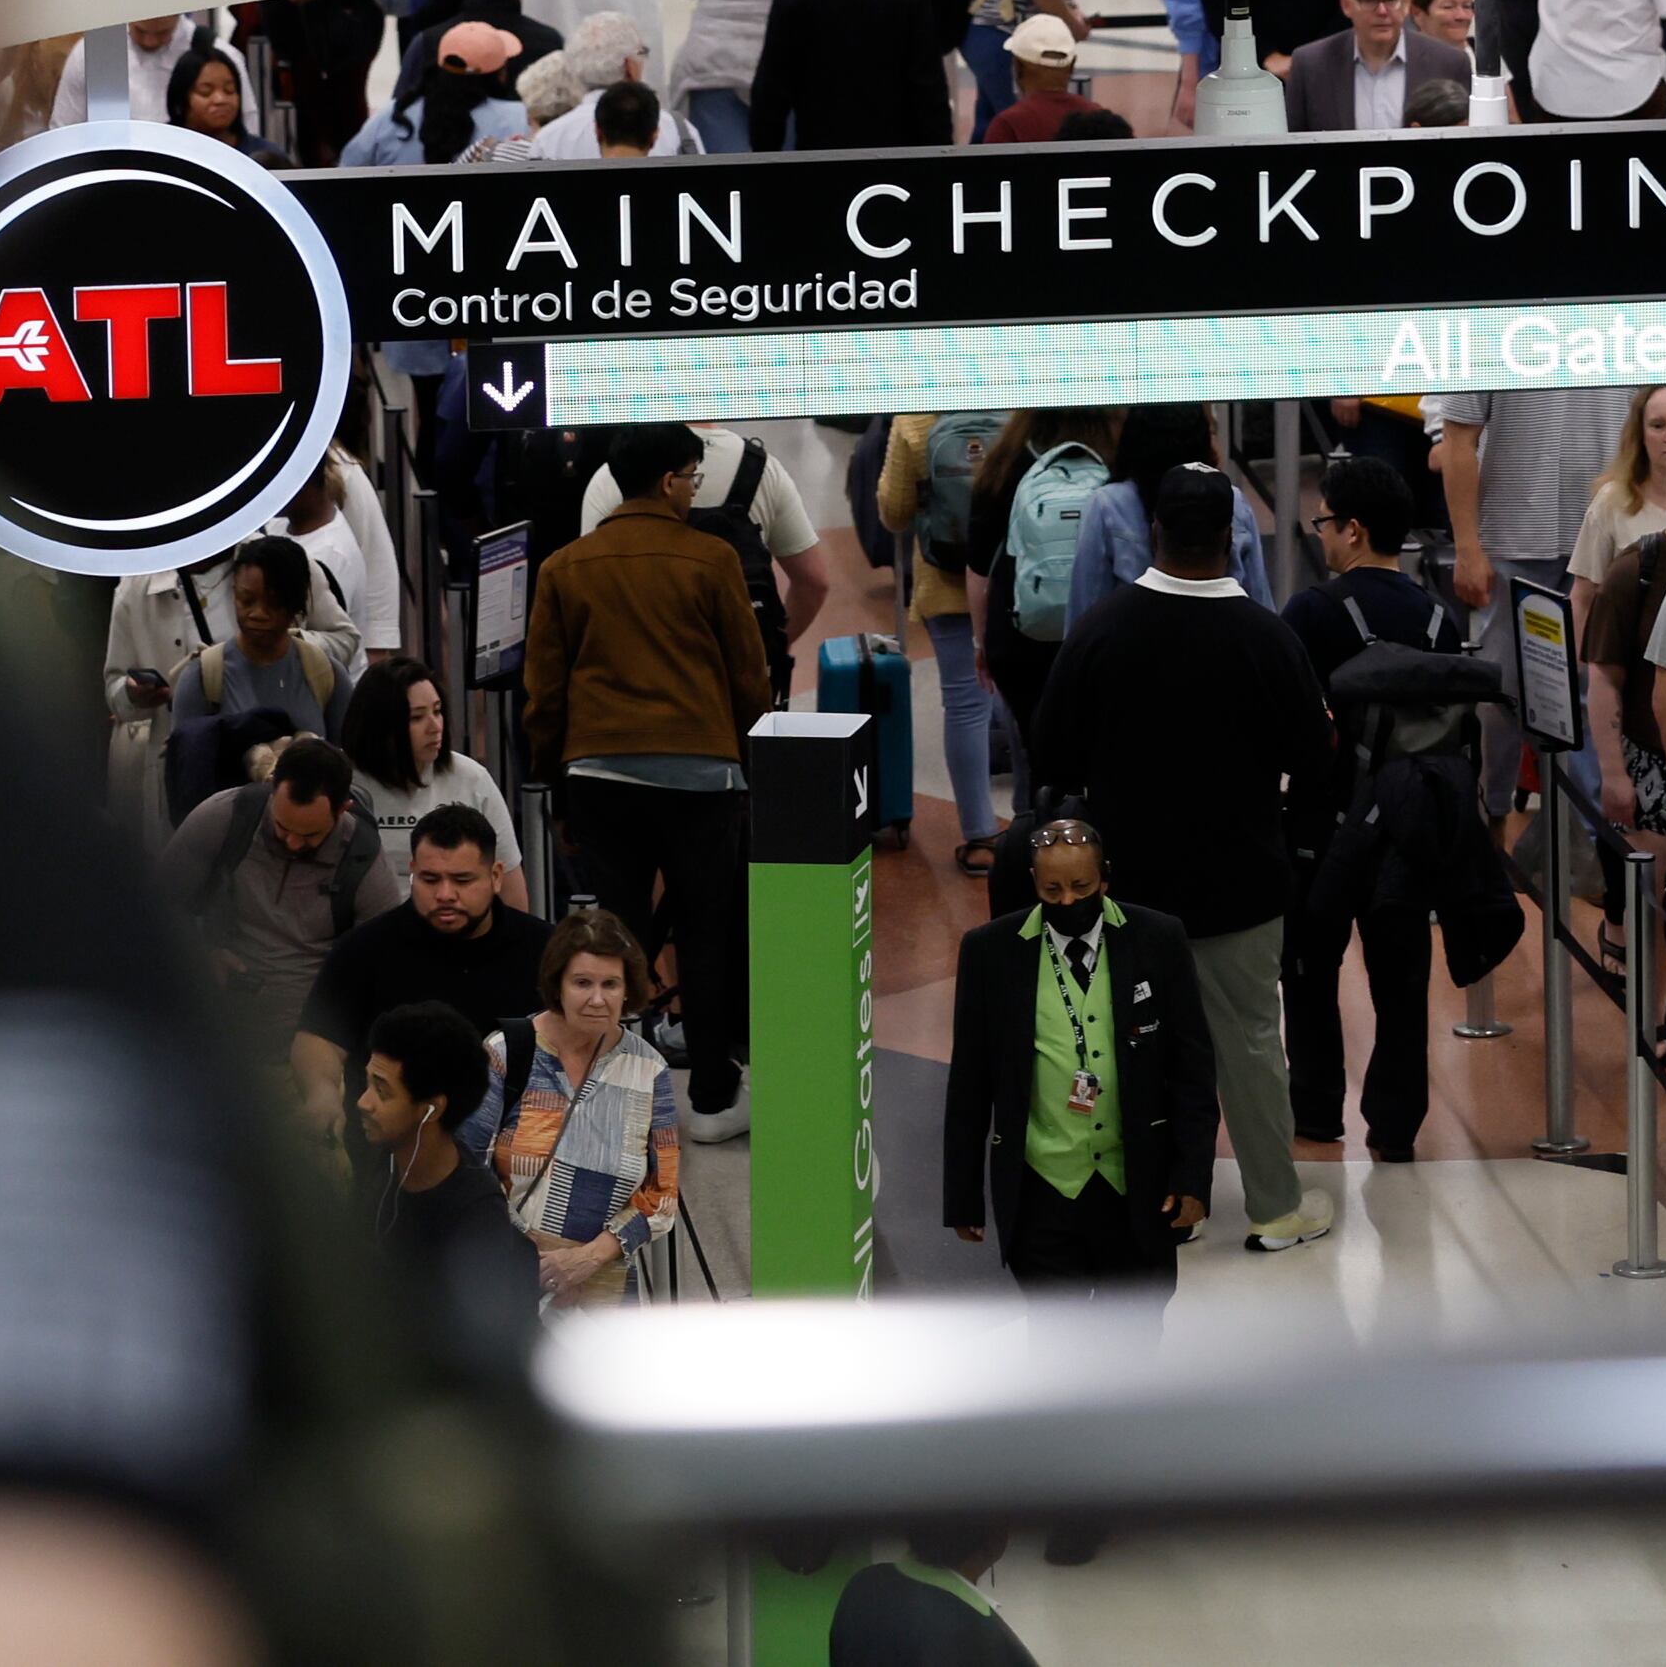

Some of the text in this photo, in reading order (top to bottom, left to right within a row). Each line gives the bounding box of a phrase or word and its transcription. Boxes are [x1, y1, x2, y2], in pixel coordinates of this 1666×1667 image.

[392, 190, 742, 274] MAIN
[392, 268, 918, 327] Control de Seguridad
[1383, 318, 1469, 382] All
[853, 949, 874, 1304] All Gates
